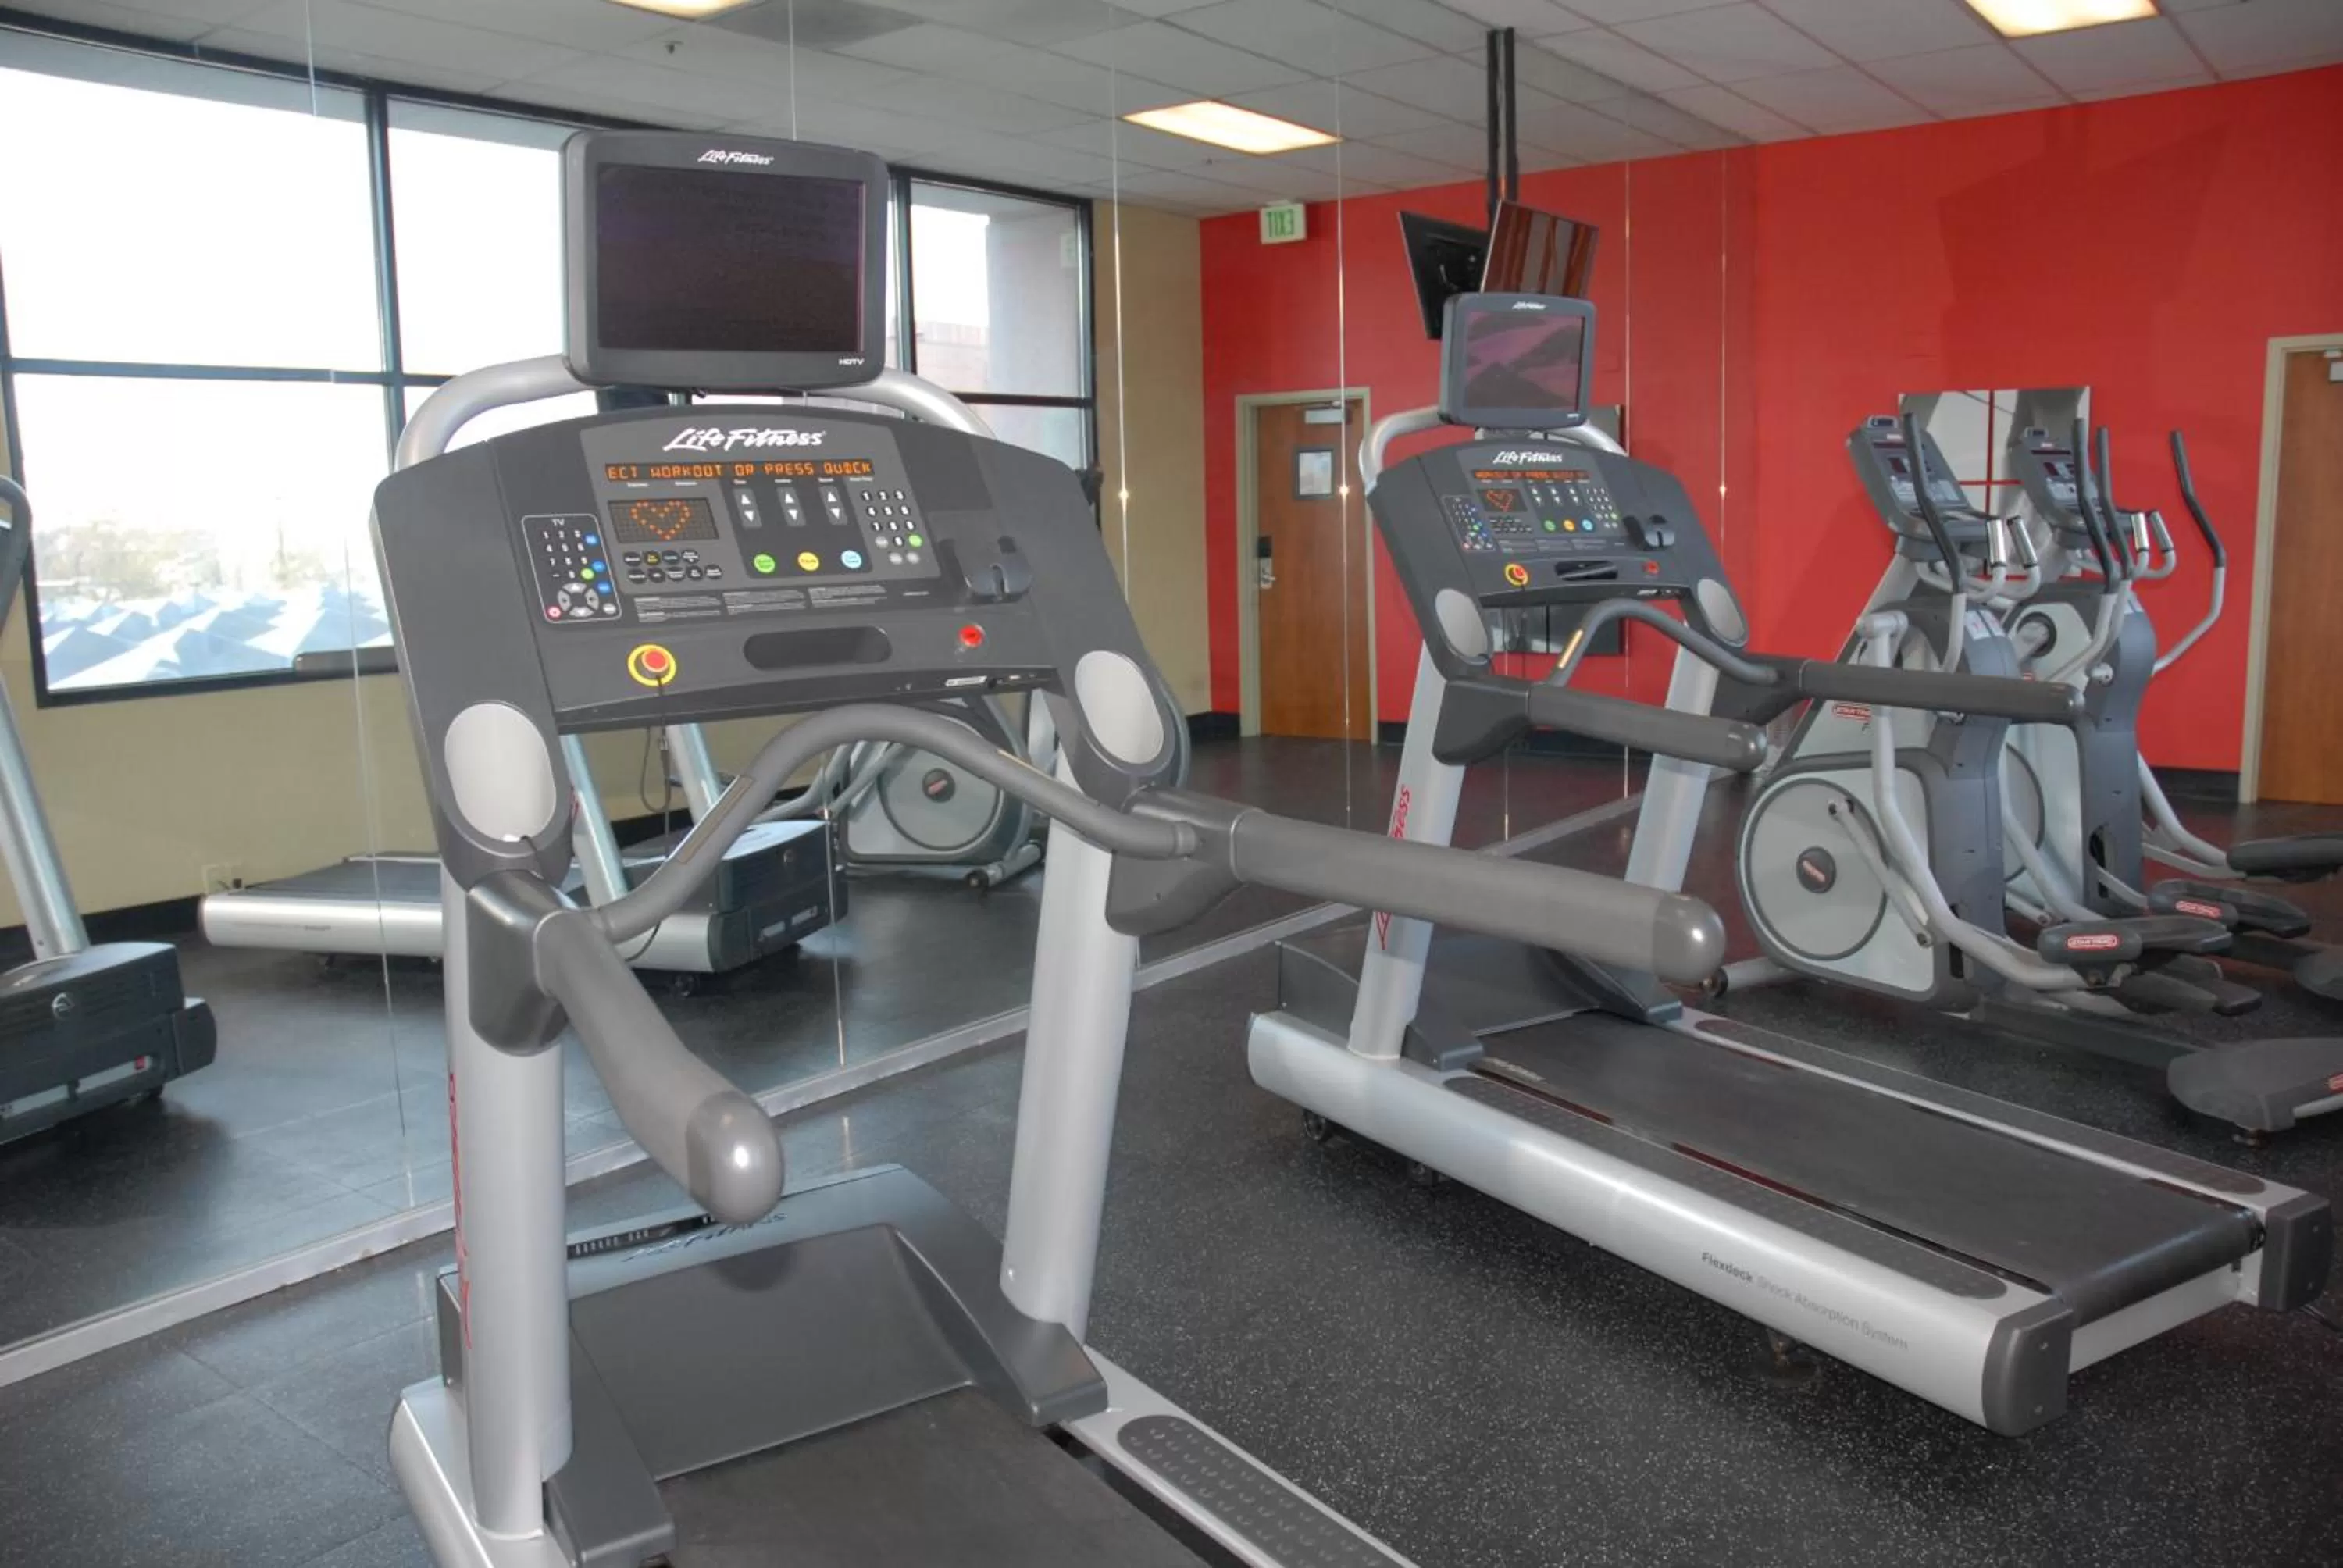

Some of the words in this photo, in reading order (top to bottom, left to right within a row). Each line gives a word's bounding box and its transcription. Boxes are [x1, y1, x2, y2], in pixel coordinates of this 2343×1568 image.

[662, 427, 726, 453] Life
[723, 427, 824, 453] Fitness
[651, 464, 722, 479] WORKOUT
[765, 461, 815, 476] PRESS
